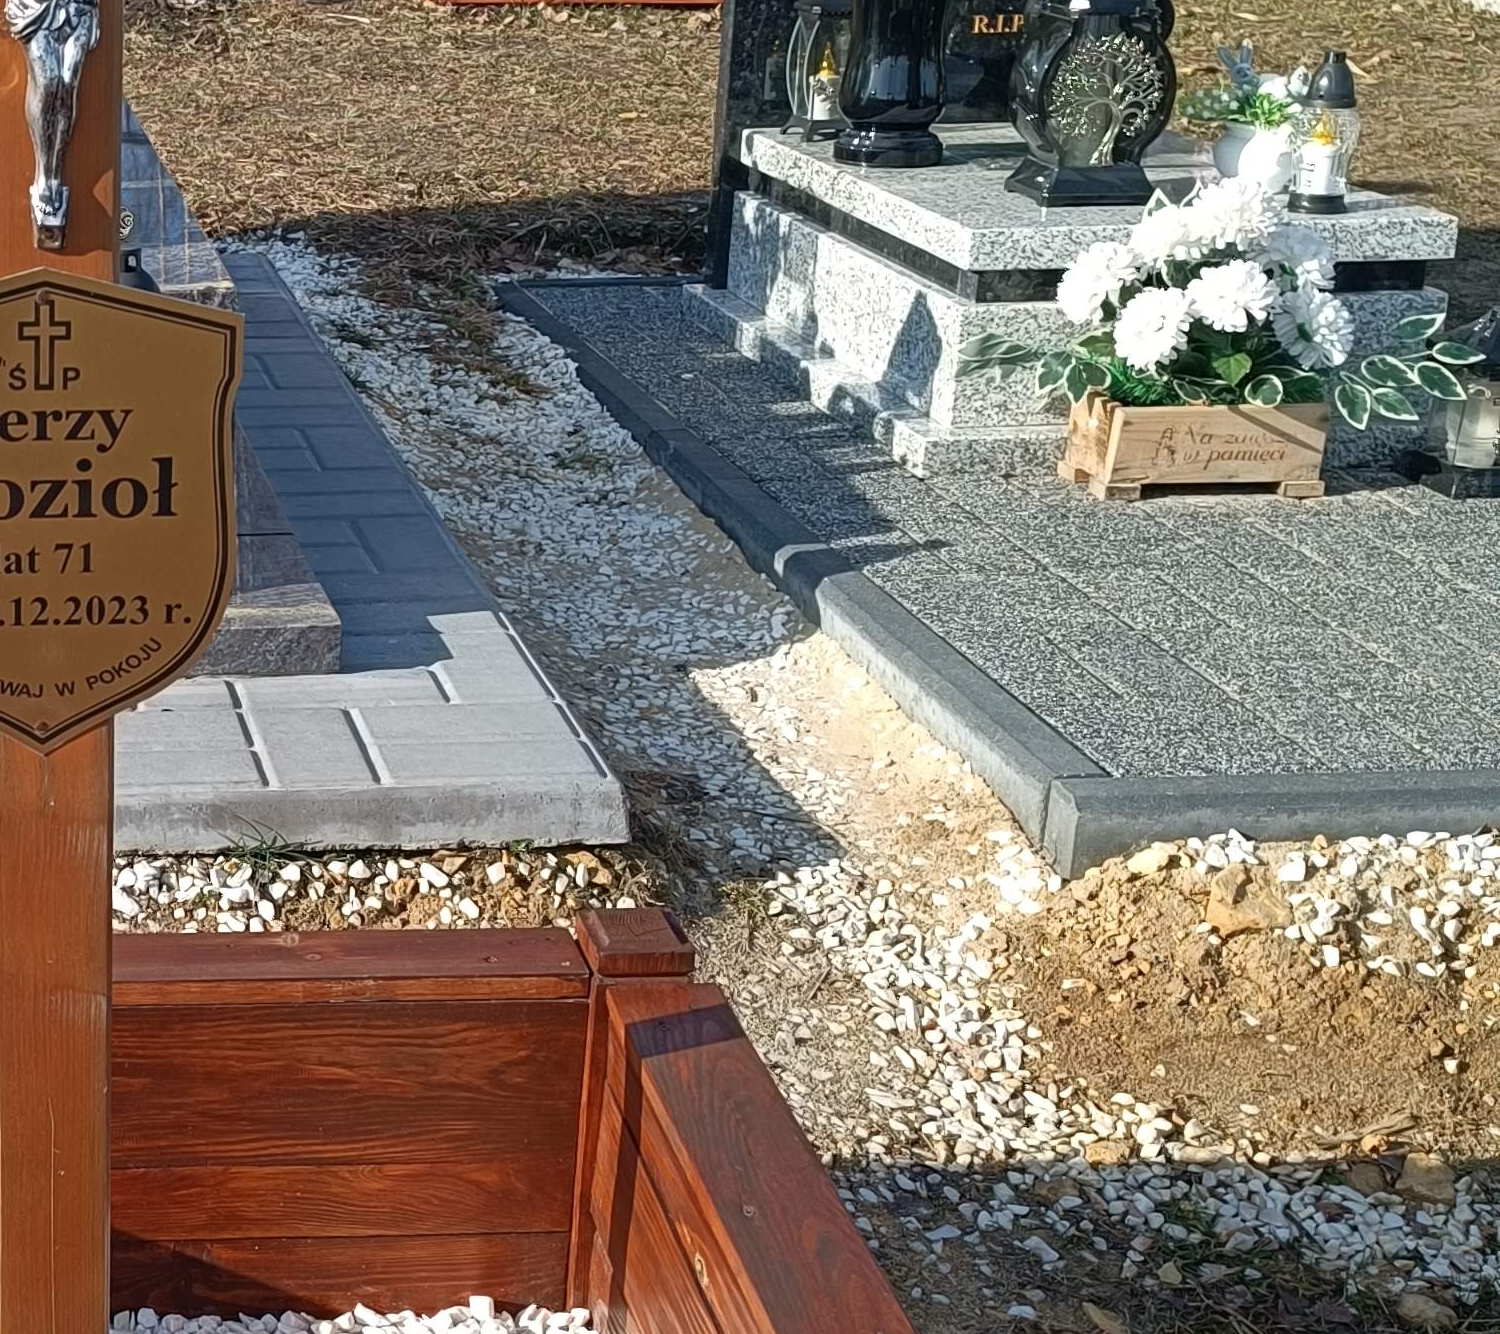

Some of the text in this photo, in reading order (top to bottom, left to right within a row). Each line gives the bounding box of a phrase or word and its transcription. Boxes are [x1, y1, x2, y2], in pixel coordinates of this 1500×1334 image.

[8, 363, 81, 391] Ś P
[1203, 449, 1286, 471] pamięci
[53, 541, 94, 574] 71
[163, 601, 192, 625] r.
[54, 680, 76, 698] W
[84, 636, 163, 692] POKOJU
